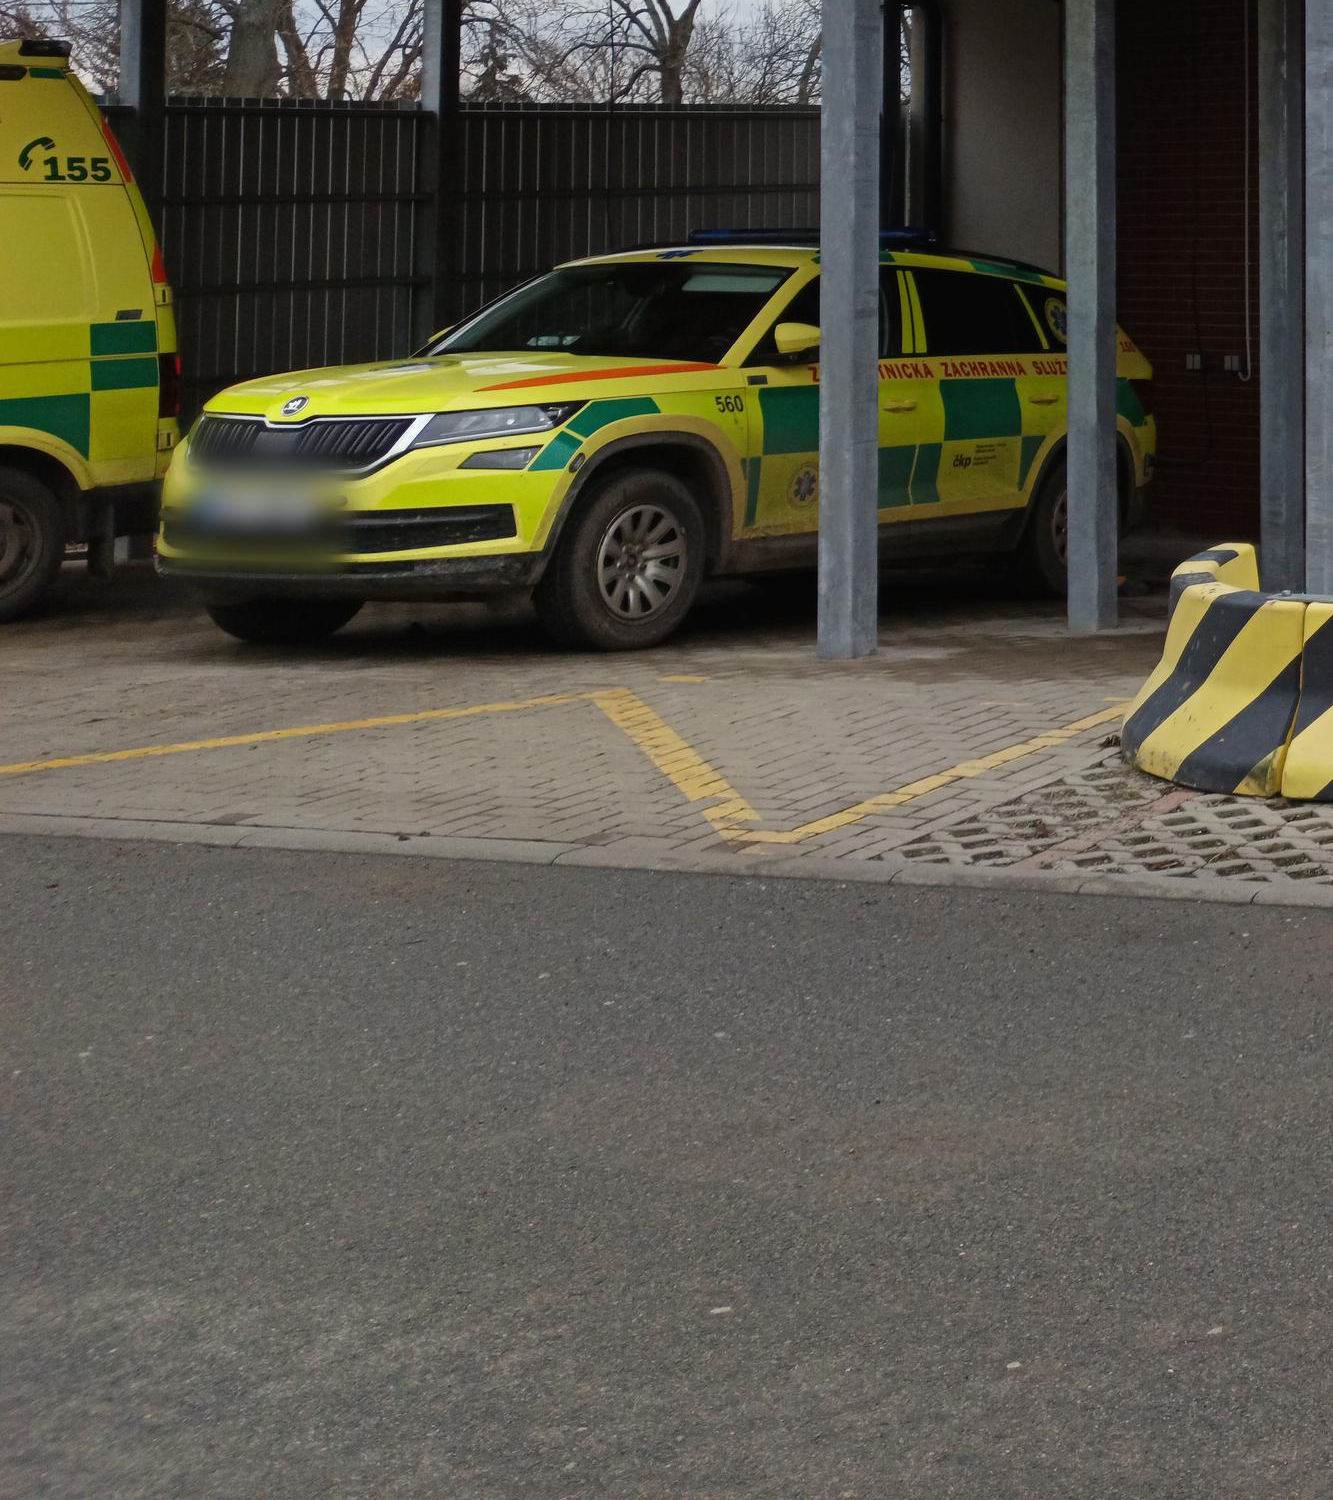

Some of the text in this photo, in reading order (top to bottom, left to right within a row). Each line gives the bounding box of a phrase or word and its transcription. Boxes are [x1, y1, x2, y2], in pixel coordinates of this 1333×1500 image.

[43, 156, 112, 182] 155
[939, 358, 1027, 378] ZÁCHRANNÁ
[715, 395, 744, 413] 560
